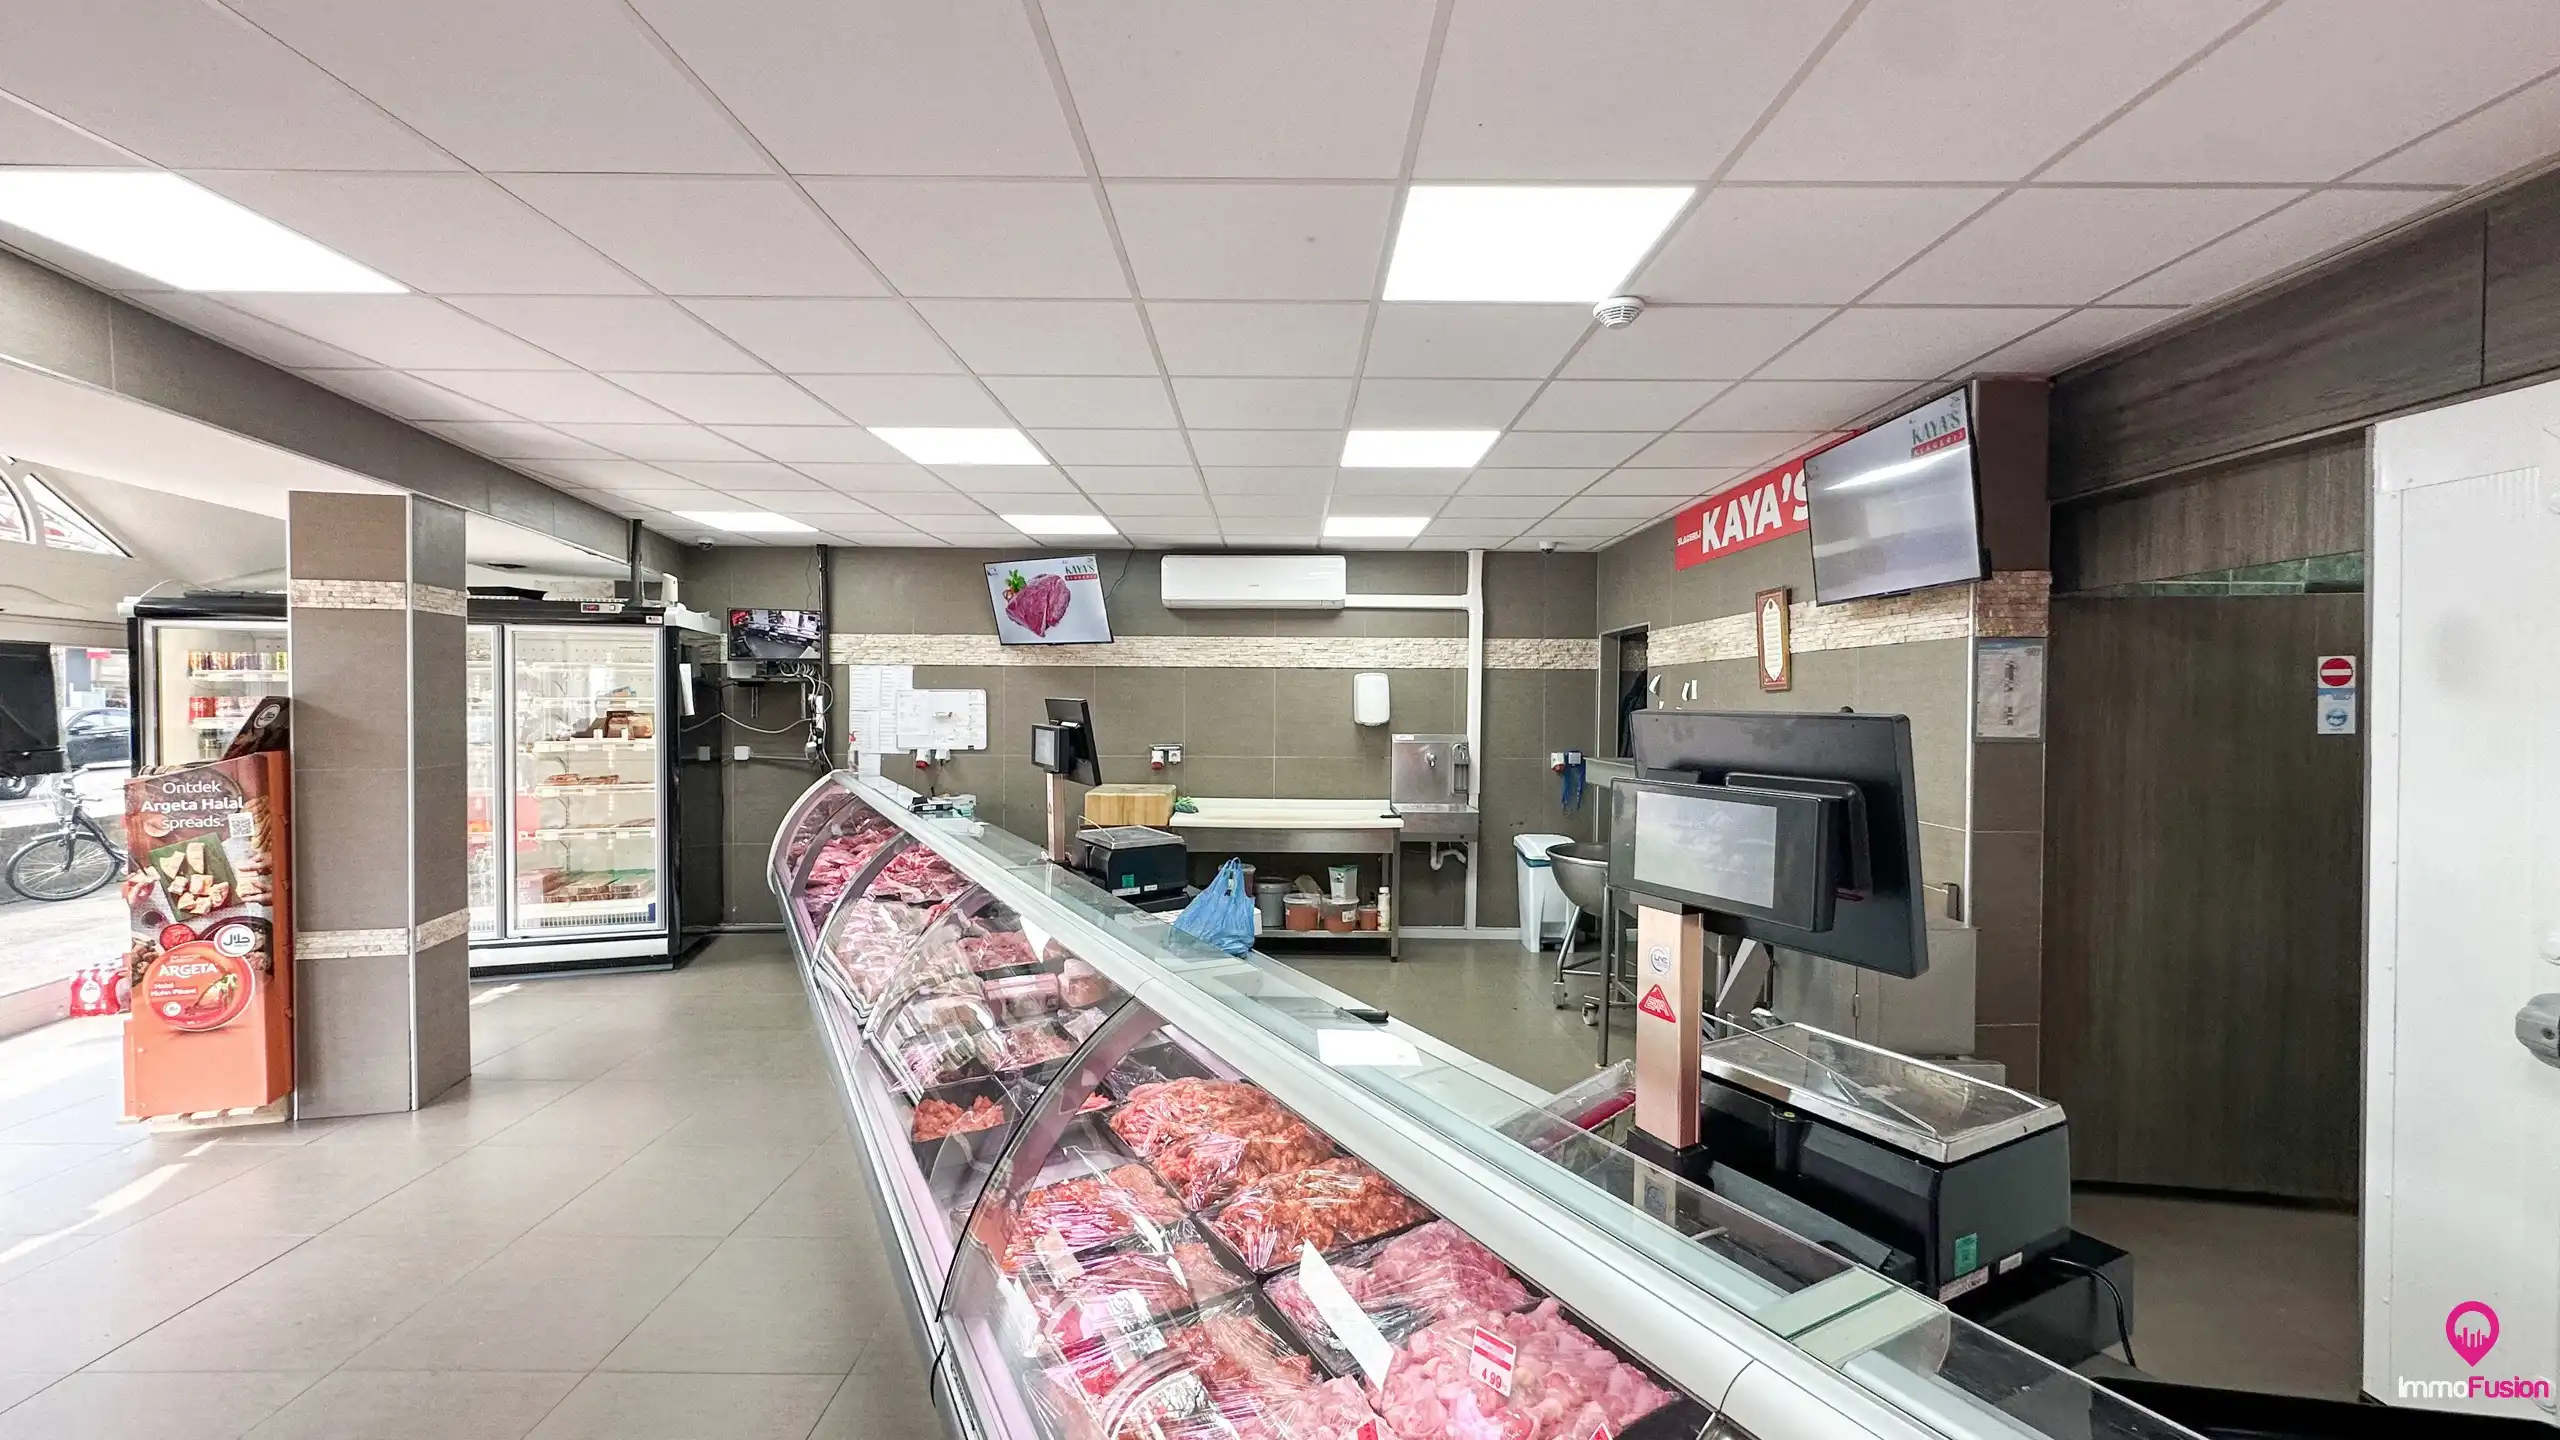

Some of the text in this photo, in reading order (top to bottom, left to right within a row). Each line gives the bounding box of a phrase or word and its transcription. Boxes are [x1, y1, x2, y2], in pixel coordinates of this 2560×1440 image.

[1702, 468, 1808, 554] KAYA'S
[162, 780, 222, 794] Ontdek
[141, 796, 244, 814] Argeta Halal
[161, 815, 225, 832] spreads.
[159, 963, 218, 978] ARGETA
